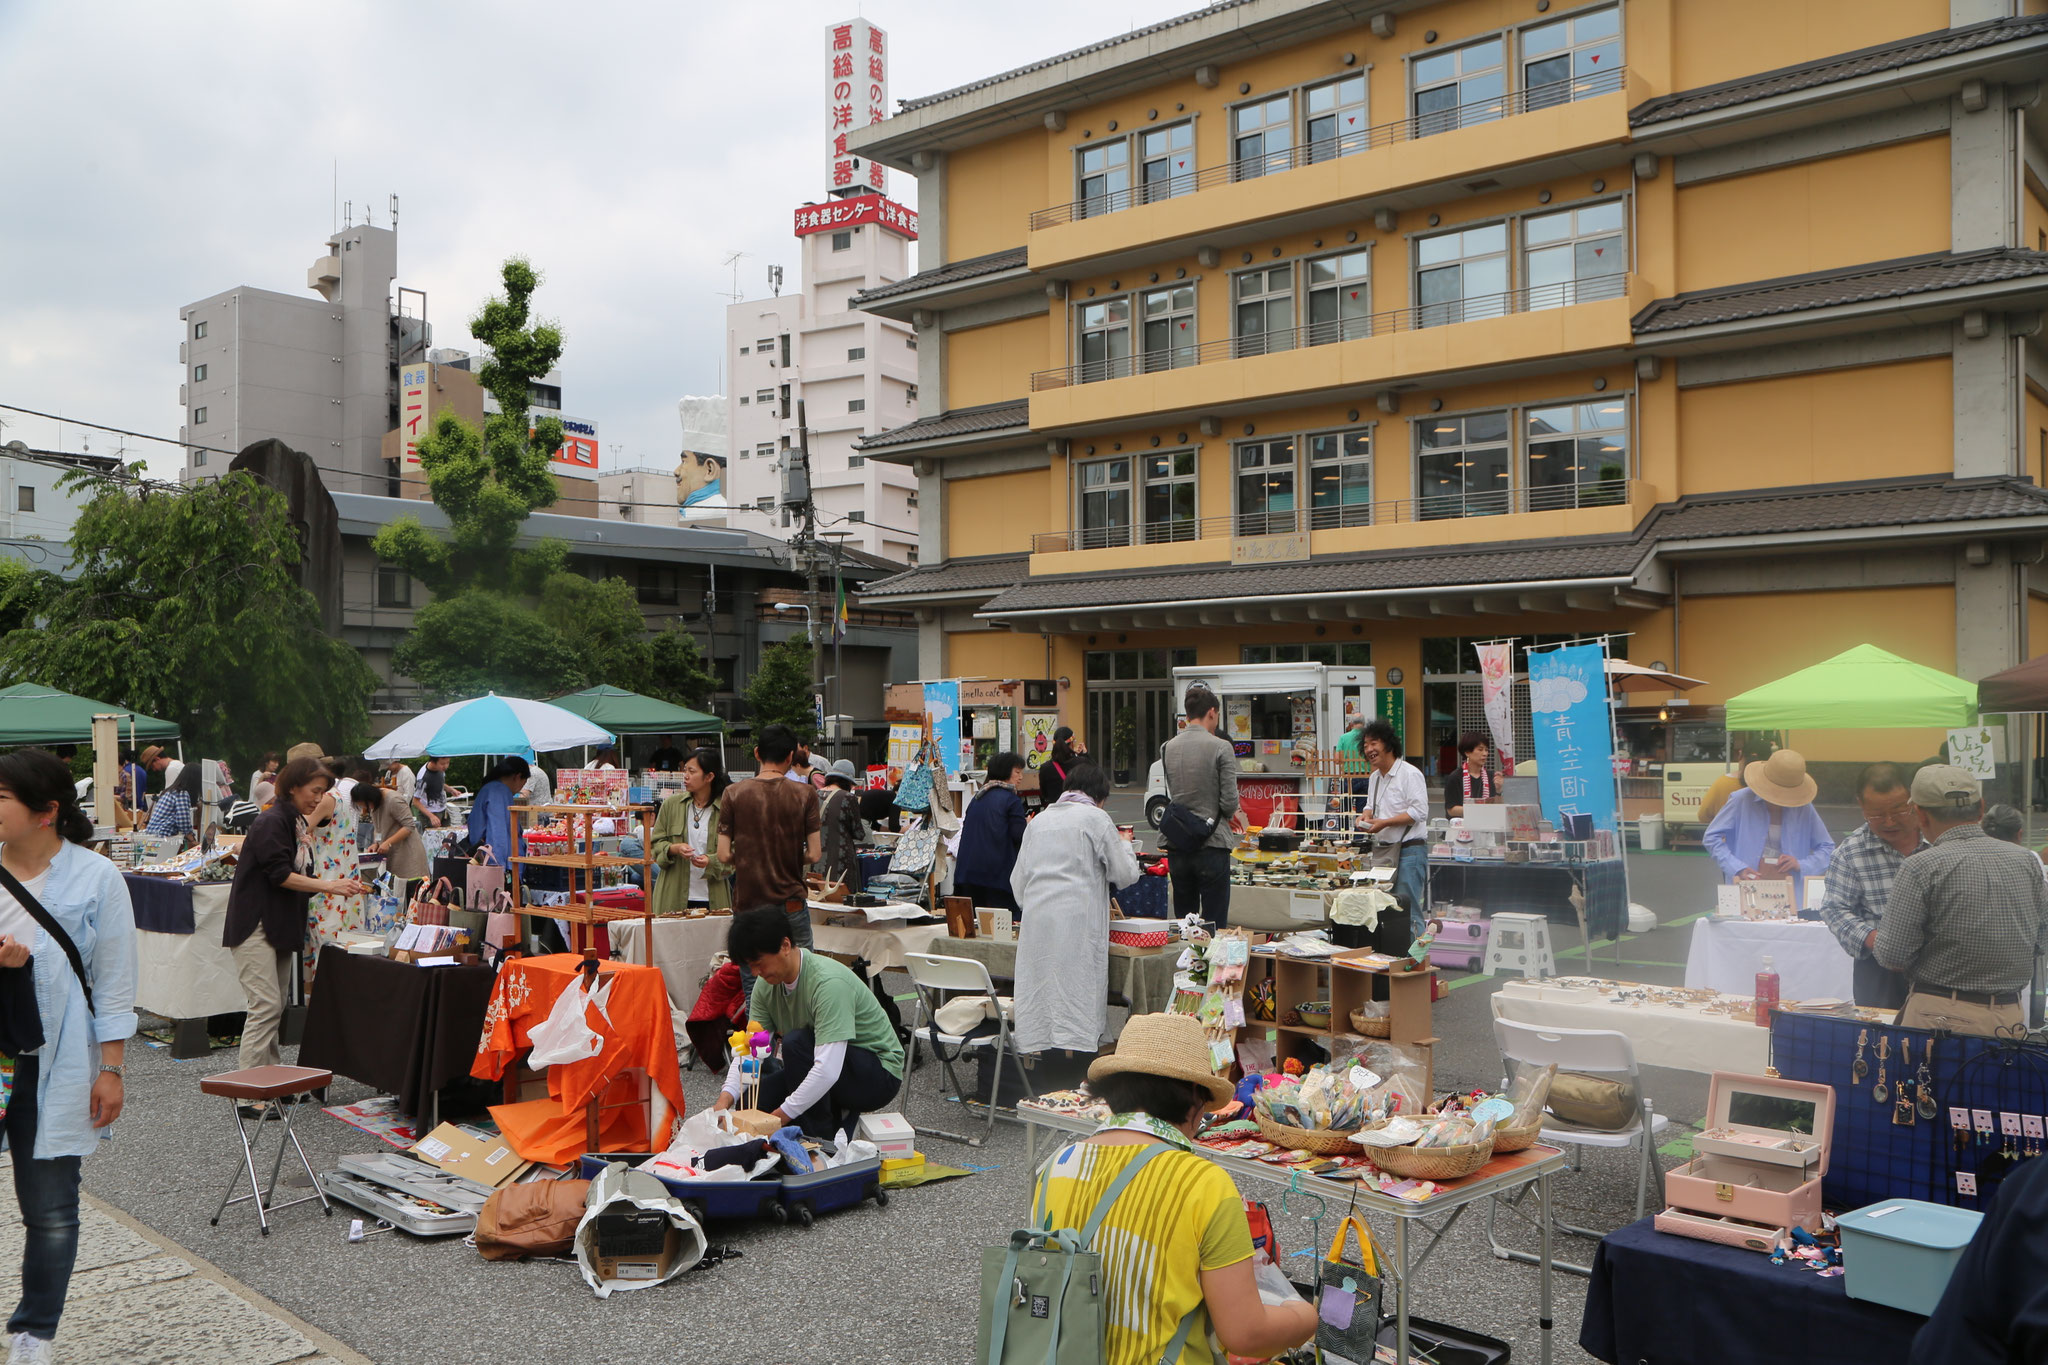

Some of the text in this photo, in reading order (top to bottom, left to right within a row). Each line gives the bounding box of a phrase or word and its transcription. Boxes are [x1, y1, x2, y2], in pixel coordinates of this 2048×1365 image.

[832, 24, 853, 187] 高総の洋食器
[868, 26, 884, 189] 高総の洋器
[796, 202, 873, 230] 洋食器センター
[403, 370, 425, 387] 食器
[407, 390, 422, 464] ニイミ
[985, 687, 1001, 697] cafe
